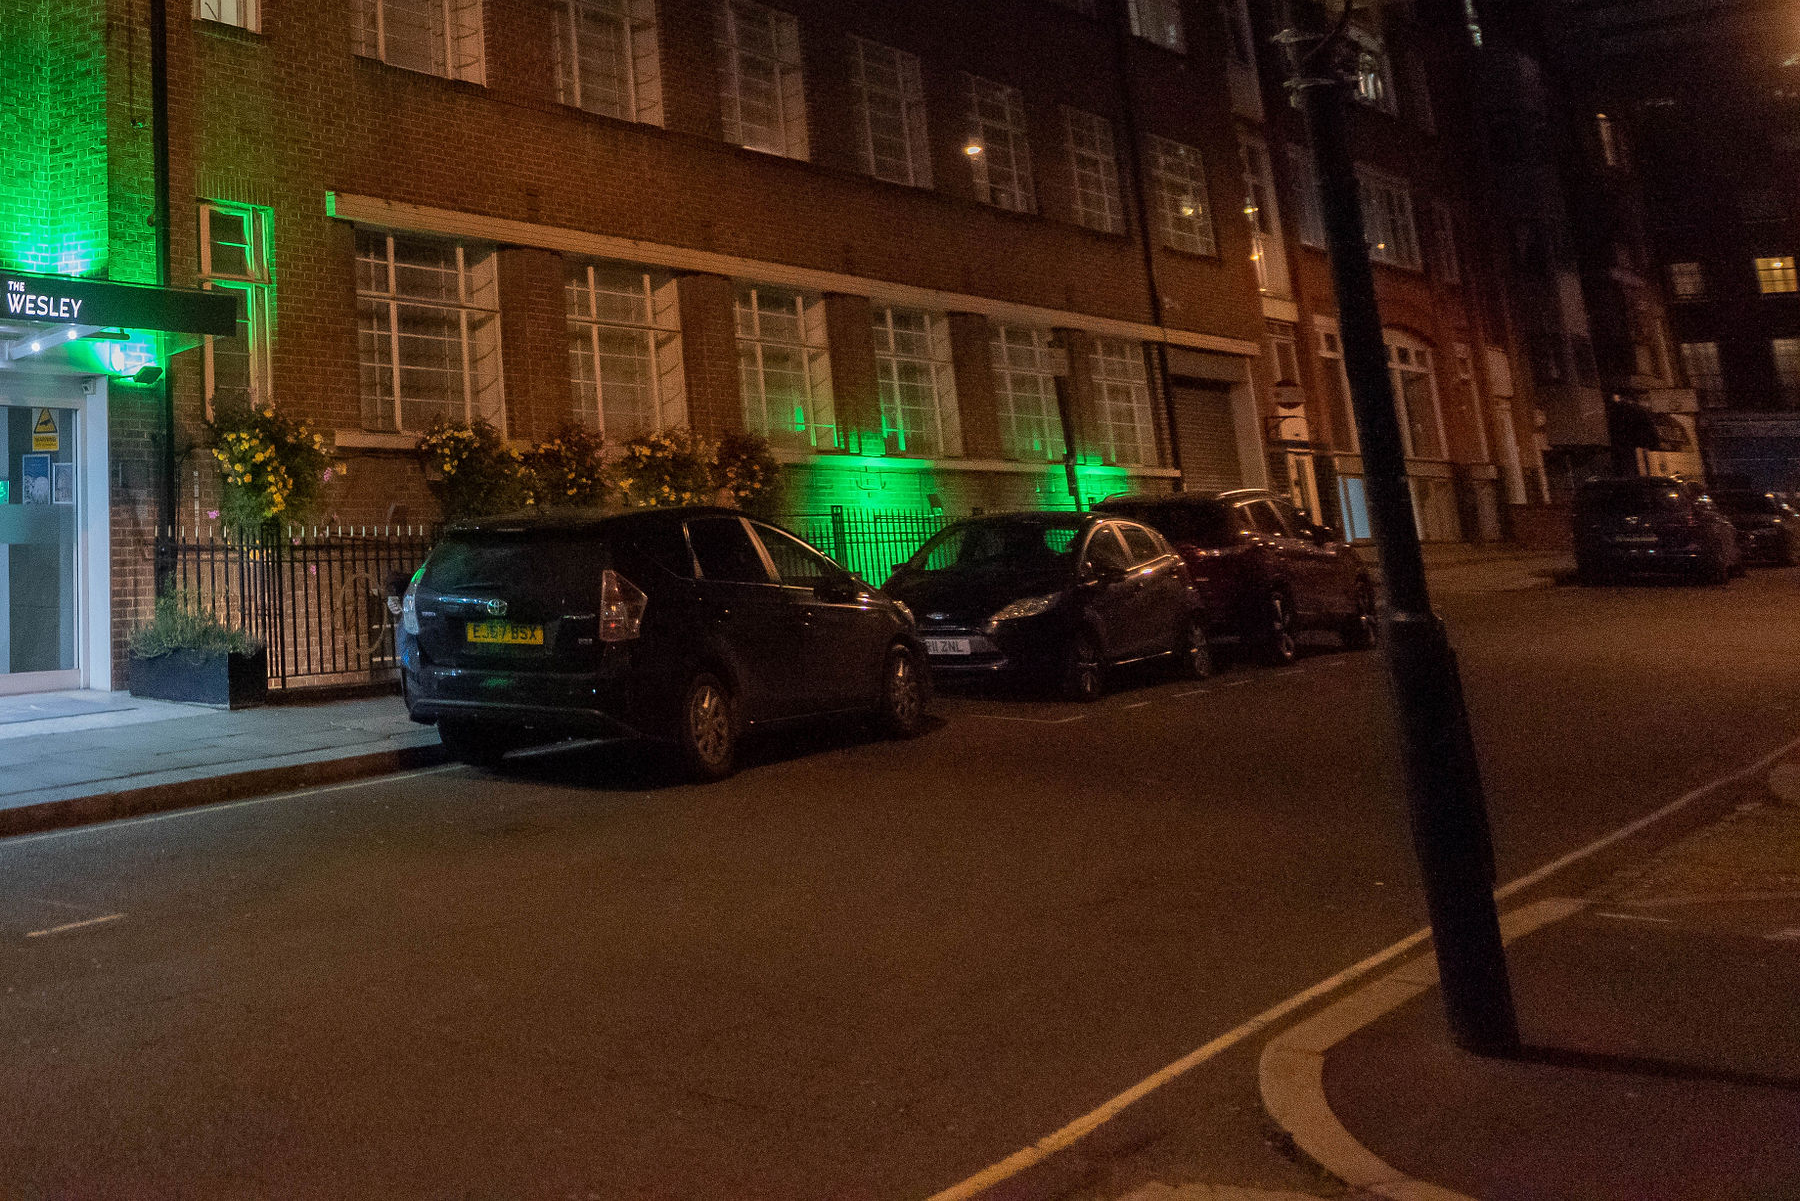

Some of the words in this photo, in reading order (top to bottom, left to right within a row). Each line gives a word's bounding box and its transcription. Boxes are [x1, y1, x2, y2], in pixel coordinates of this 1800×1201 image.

[8, 280, 25, 292] THE
[6, 292, 82, 319] WESLEY
[511, 625, 537, 641] BSX
[940, 641, 963, 652] ZNL
